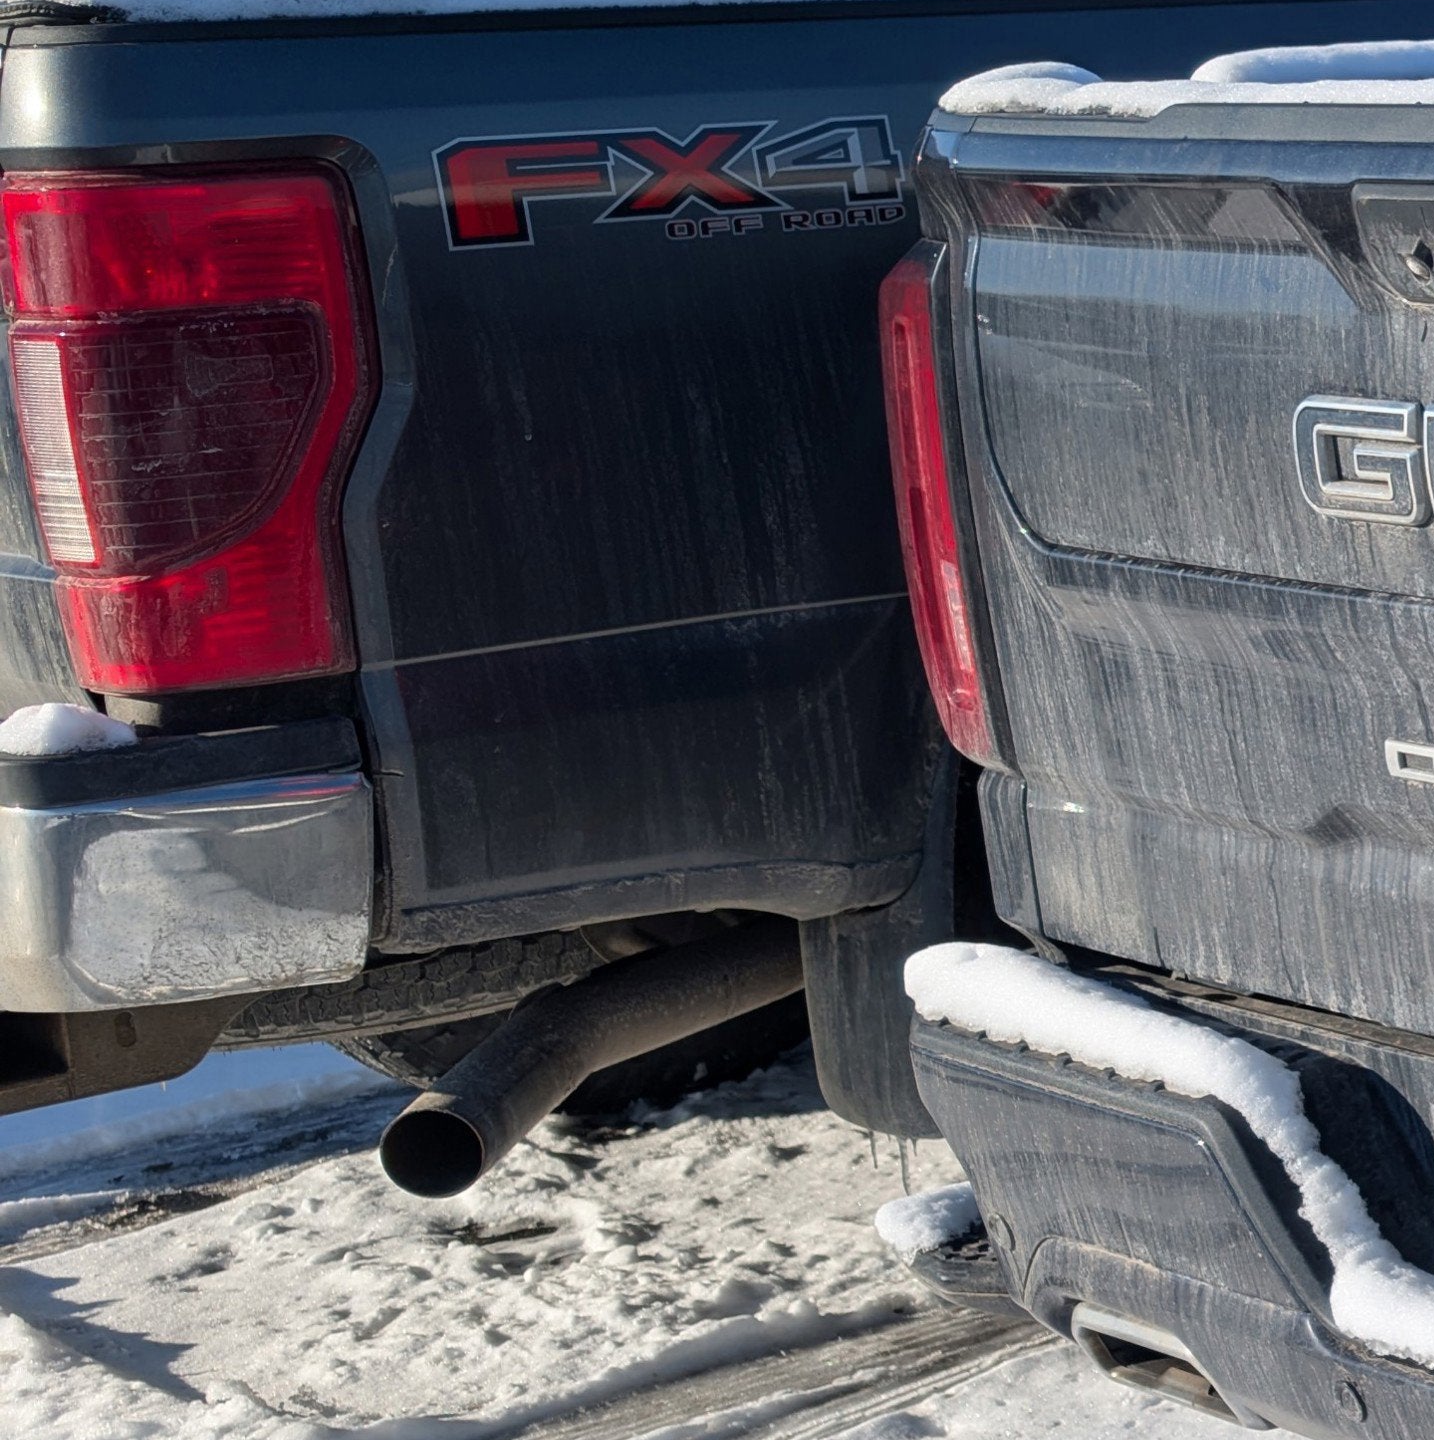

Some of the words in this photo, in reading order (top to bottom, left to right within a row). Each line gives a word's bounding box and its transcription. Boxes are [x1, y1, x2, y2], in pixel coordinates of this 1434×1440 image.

[431, 115, 905, 251] FX4
[665, 216, 764, 241] OFF
[781, 206, 905, 232] ROAD
